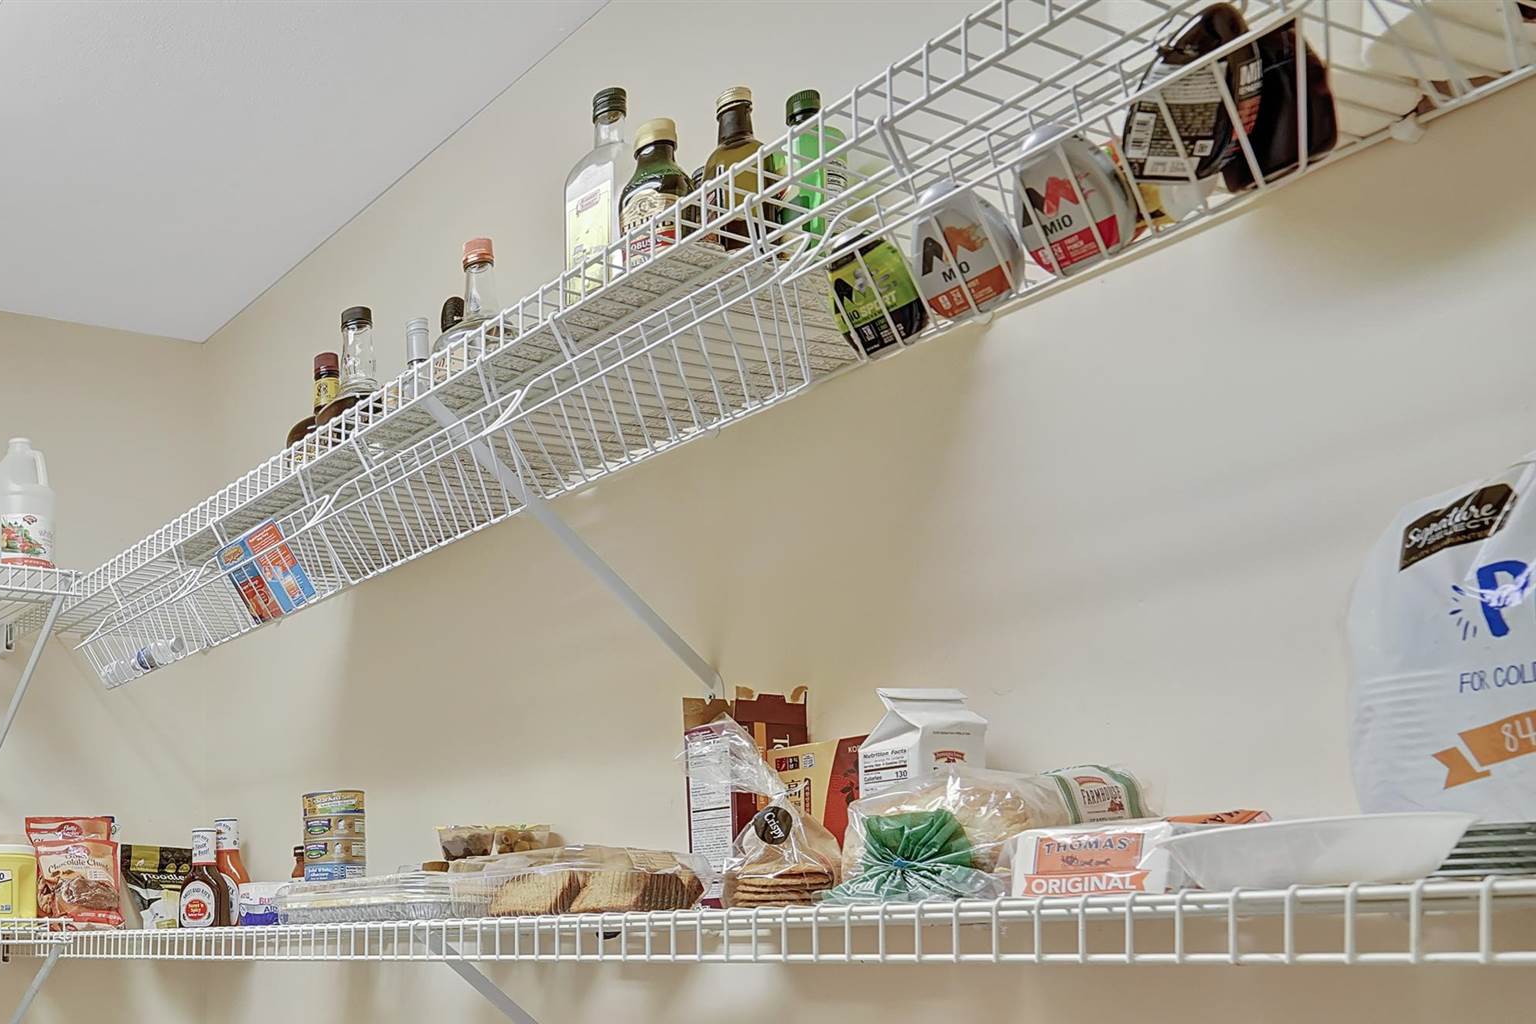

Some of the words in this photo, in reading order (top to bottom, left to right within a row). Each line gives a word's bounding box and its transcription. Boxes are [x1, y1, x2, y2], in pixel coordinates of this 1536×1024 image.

[1405, 500, 1497, 549] Signature
[1460, 671, 1490, 693] FOR
[863, 749, 890, 760] Nutrition
[864, 774, 882, 782] Calories
[895, 769, 909, 779] 130
[763, 811, 785, 840] Crispy
[1031, 876, 1138, 895] ORIGINAL
